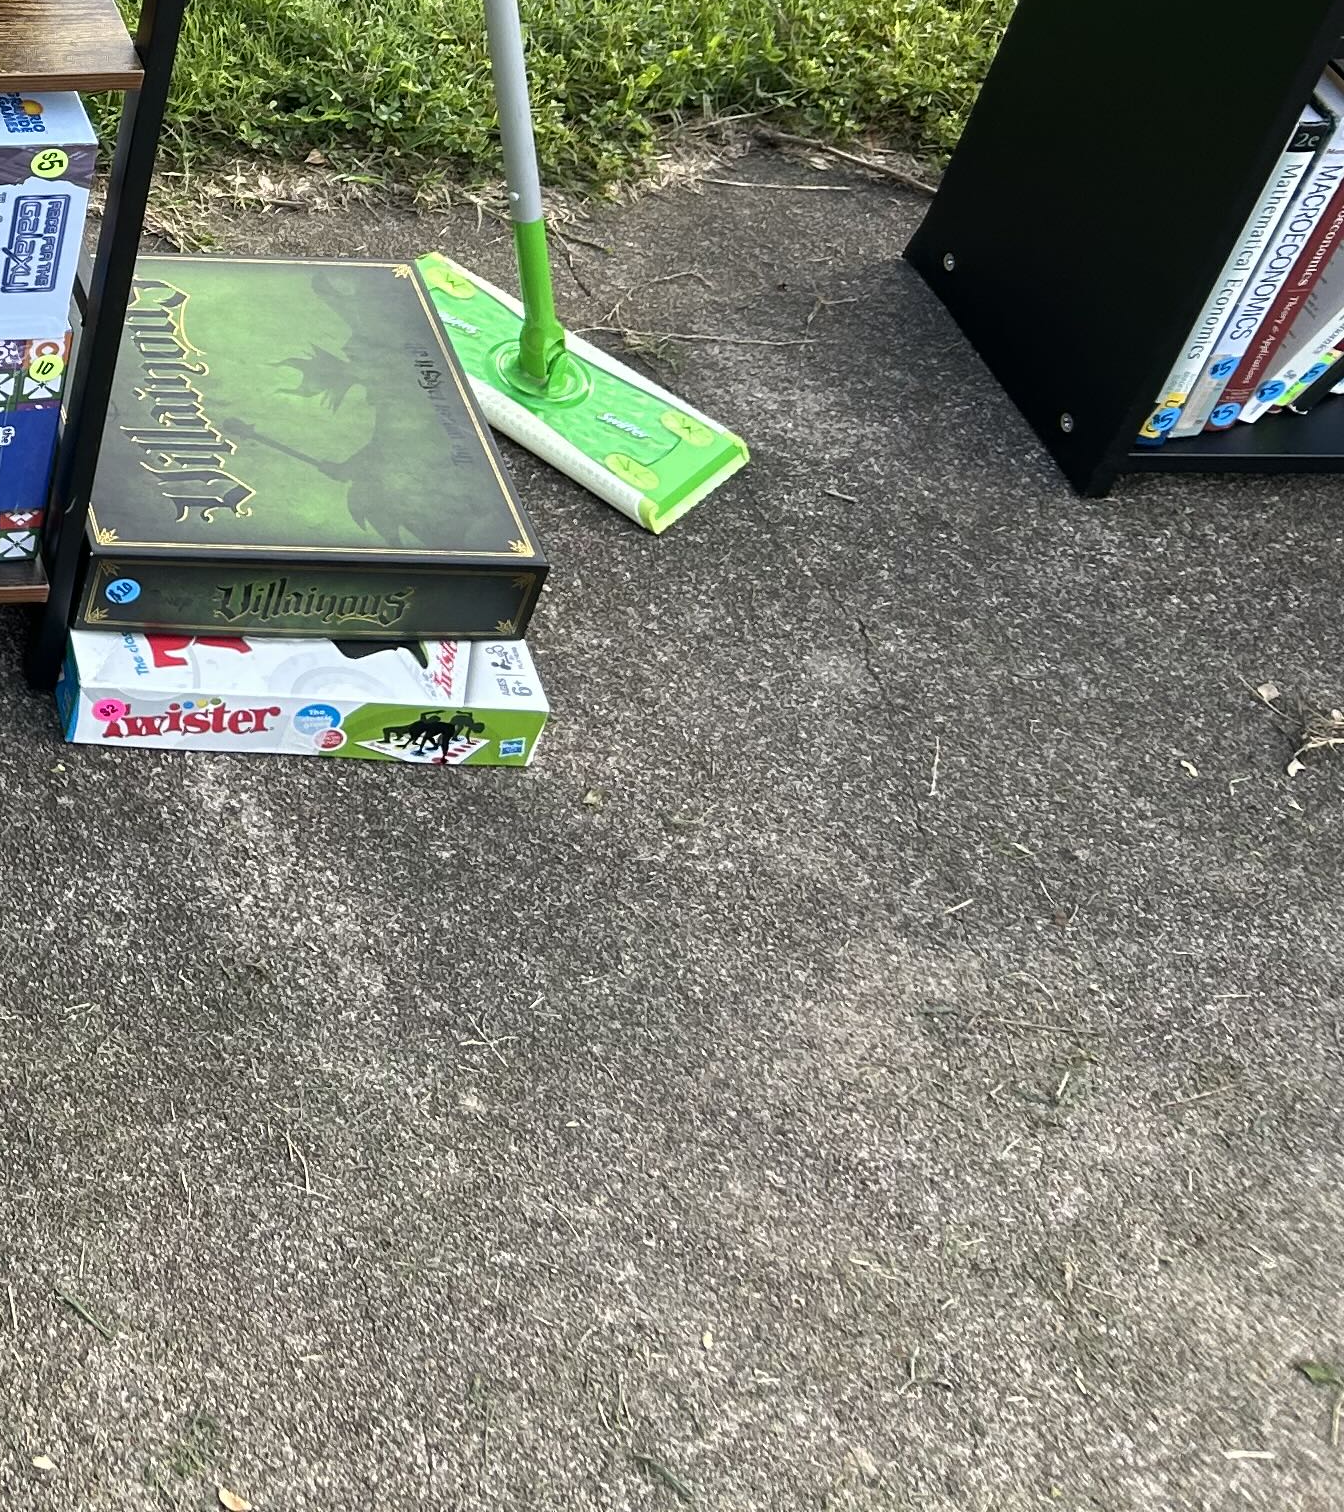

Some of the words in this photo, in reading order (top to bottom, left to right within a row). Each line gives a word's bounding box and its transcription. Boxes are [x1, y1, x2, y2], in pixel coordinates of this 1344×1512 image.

[1295, 132, 1322, 148] 2e
[36, 152, 64, 171] $5
[1232, 163, 1304, 272] Mathematical
[38, 235, 56, 261] FOR
[1229, 164, 1344, 342] MACROECONOMICS
[1186, 274, 1244, 361] Economics
[1273, 294, 1301, 326] Theory
[213, 574, 415, 628] Villainous
[102, 702, 282, 739] Twister
